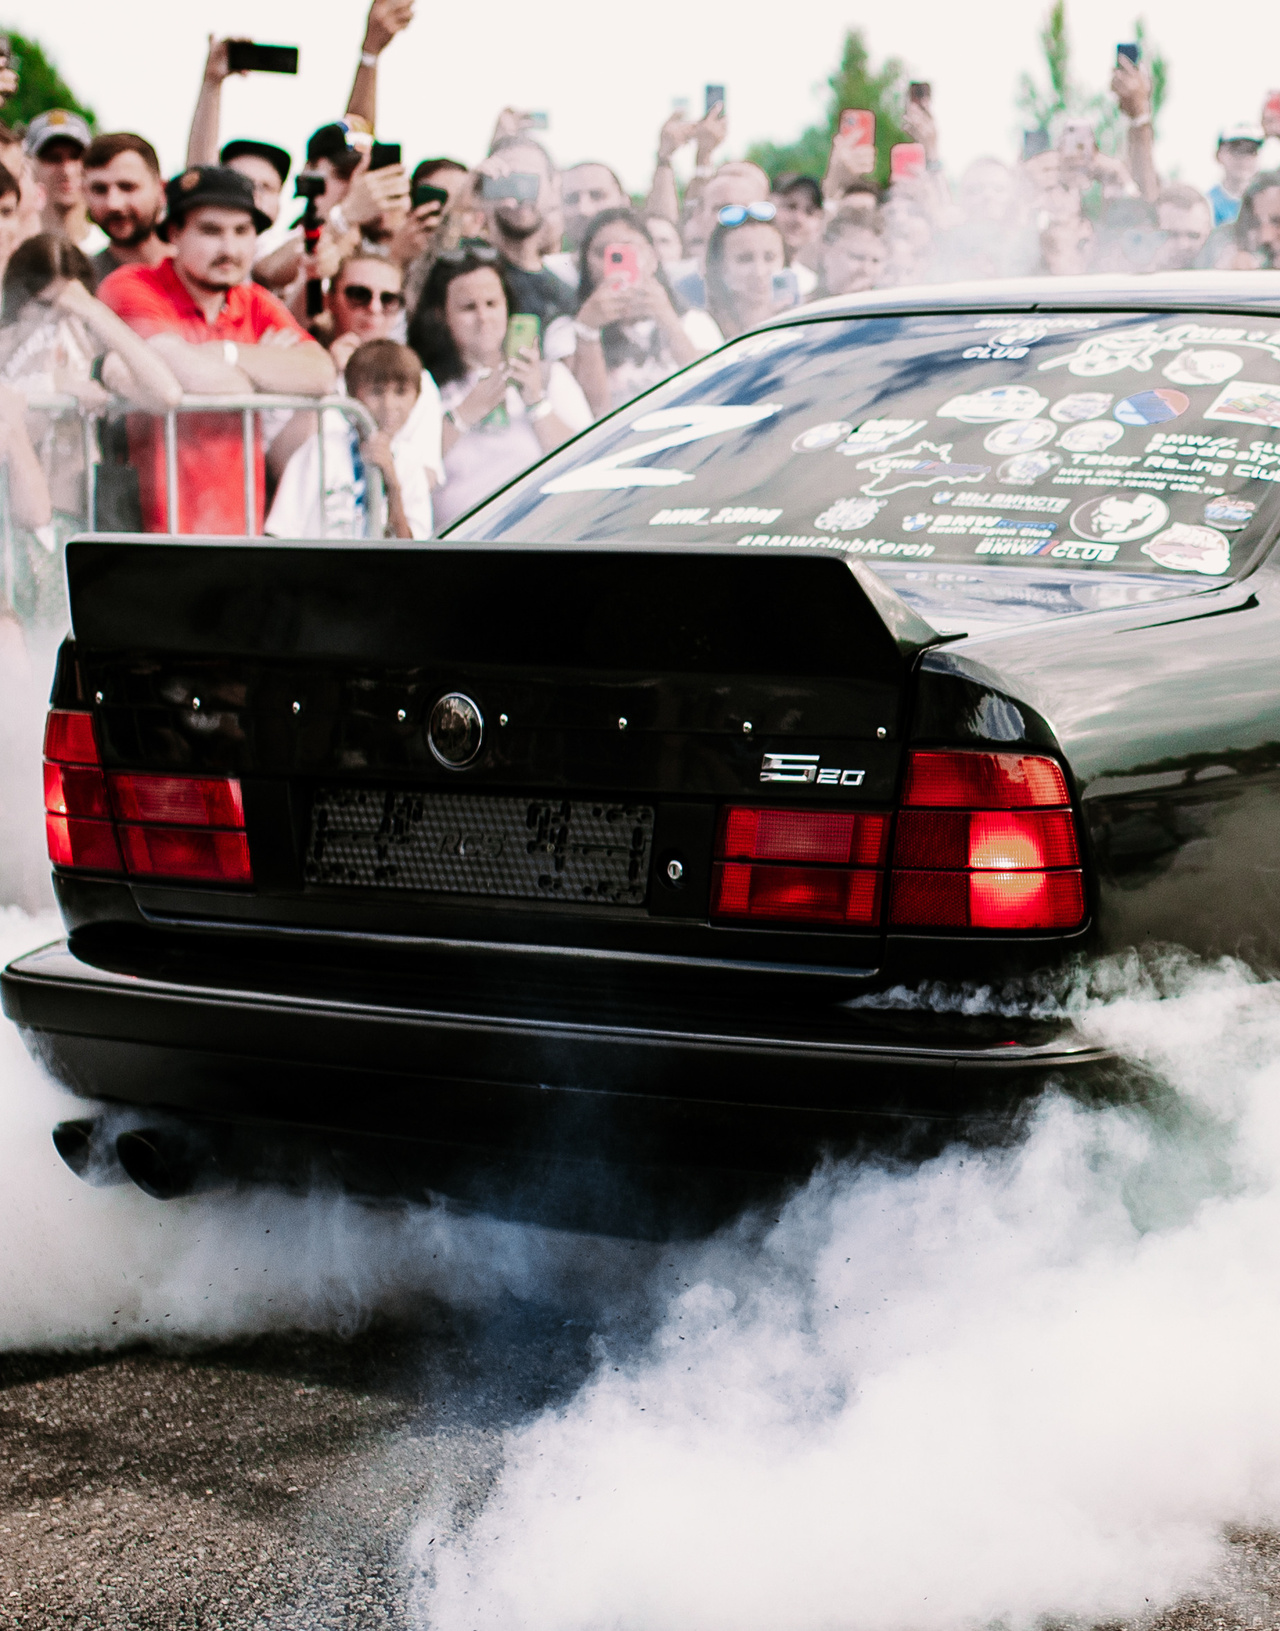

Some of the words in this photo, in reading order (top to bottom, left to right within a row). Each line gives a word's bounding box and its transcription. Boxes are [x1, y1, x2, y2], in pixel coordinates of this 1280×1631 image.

[963, 347, 1029, 359] CLUB
[1072, 453, 1141, 466] Tabor
[933, 514, 1002, 528] BMW
[1020, 528, 1051, 537] Club
[975, 541, 1035, 555] BMW
[1051, 545, 1117, 561] CLUB
[760, 753, 865, 786] 520
